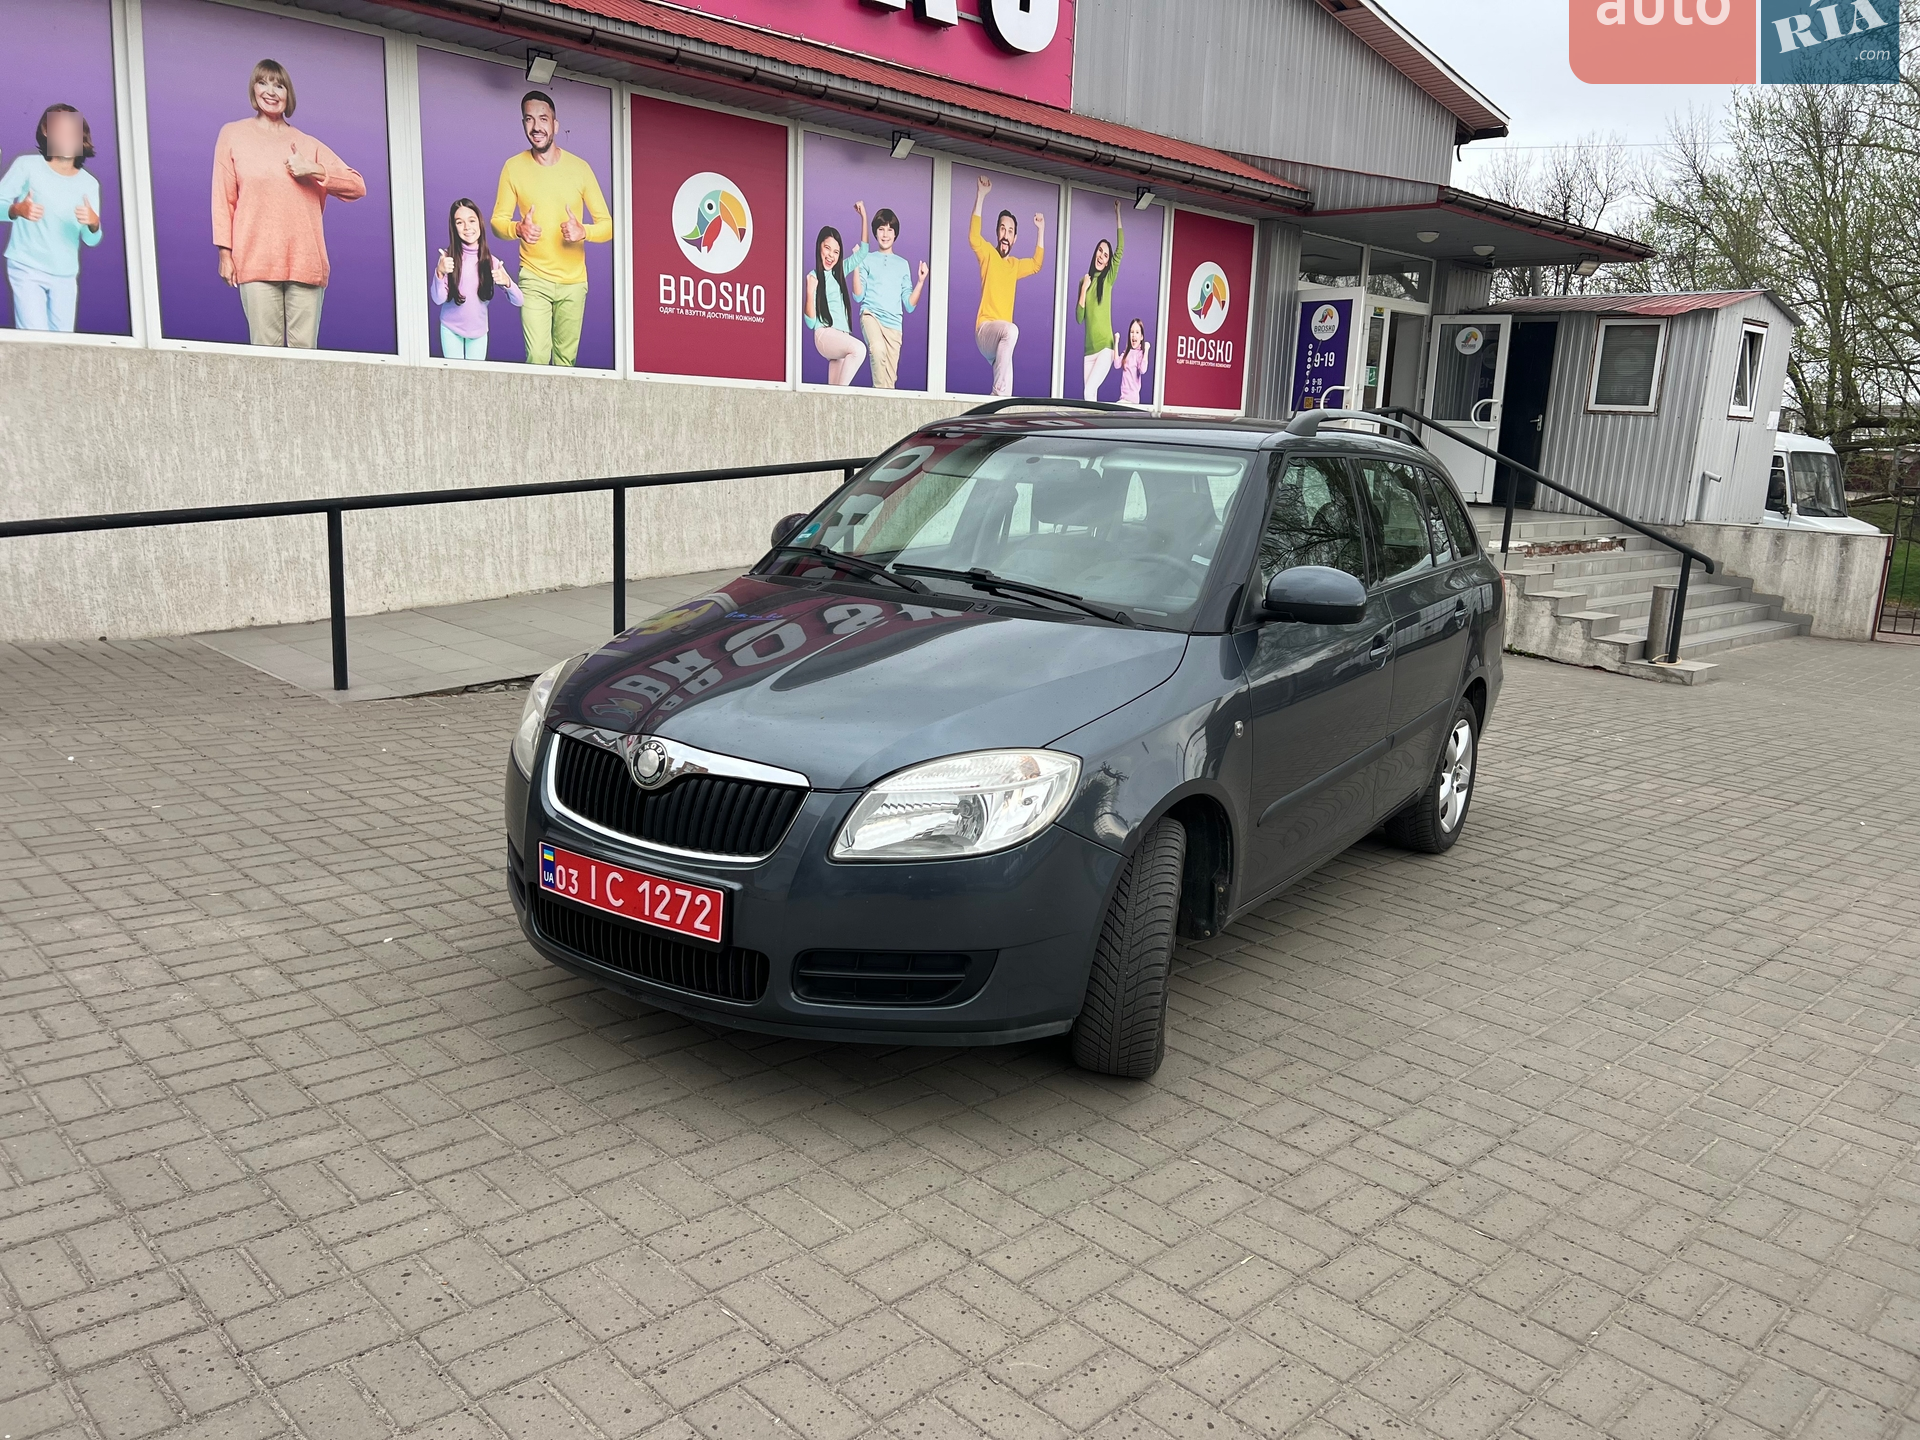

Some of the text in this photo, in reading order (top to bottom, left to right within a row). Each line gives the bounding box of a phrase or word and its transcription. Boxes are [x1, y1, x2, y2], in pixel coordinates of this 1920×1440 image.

[659, 273, 766, 316] BROSKO
[659, 306, 675, 315] ОДЯГ
[685, 309, 706, 317] ВЗУТТЯ
[1177, 335, 1233, 363] BROSKO
[1314, 352, 1335, 368] 9-19
[543, 870, 555, 884] UA
[556, 864, 579, 895] 03
[637, 880, 712, 933] 1272
